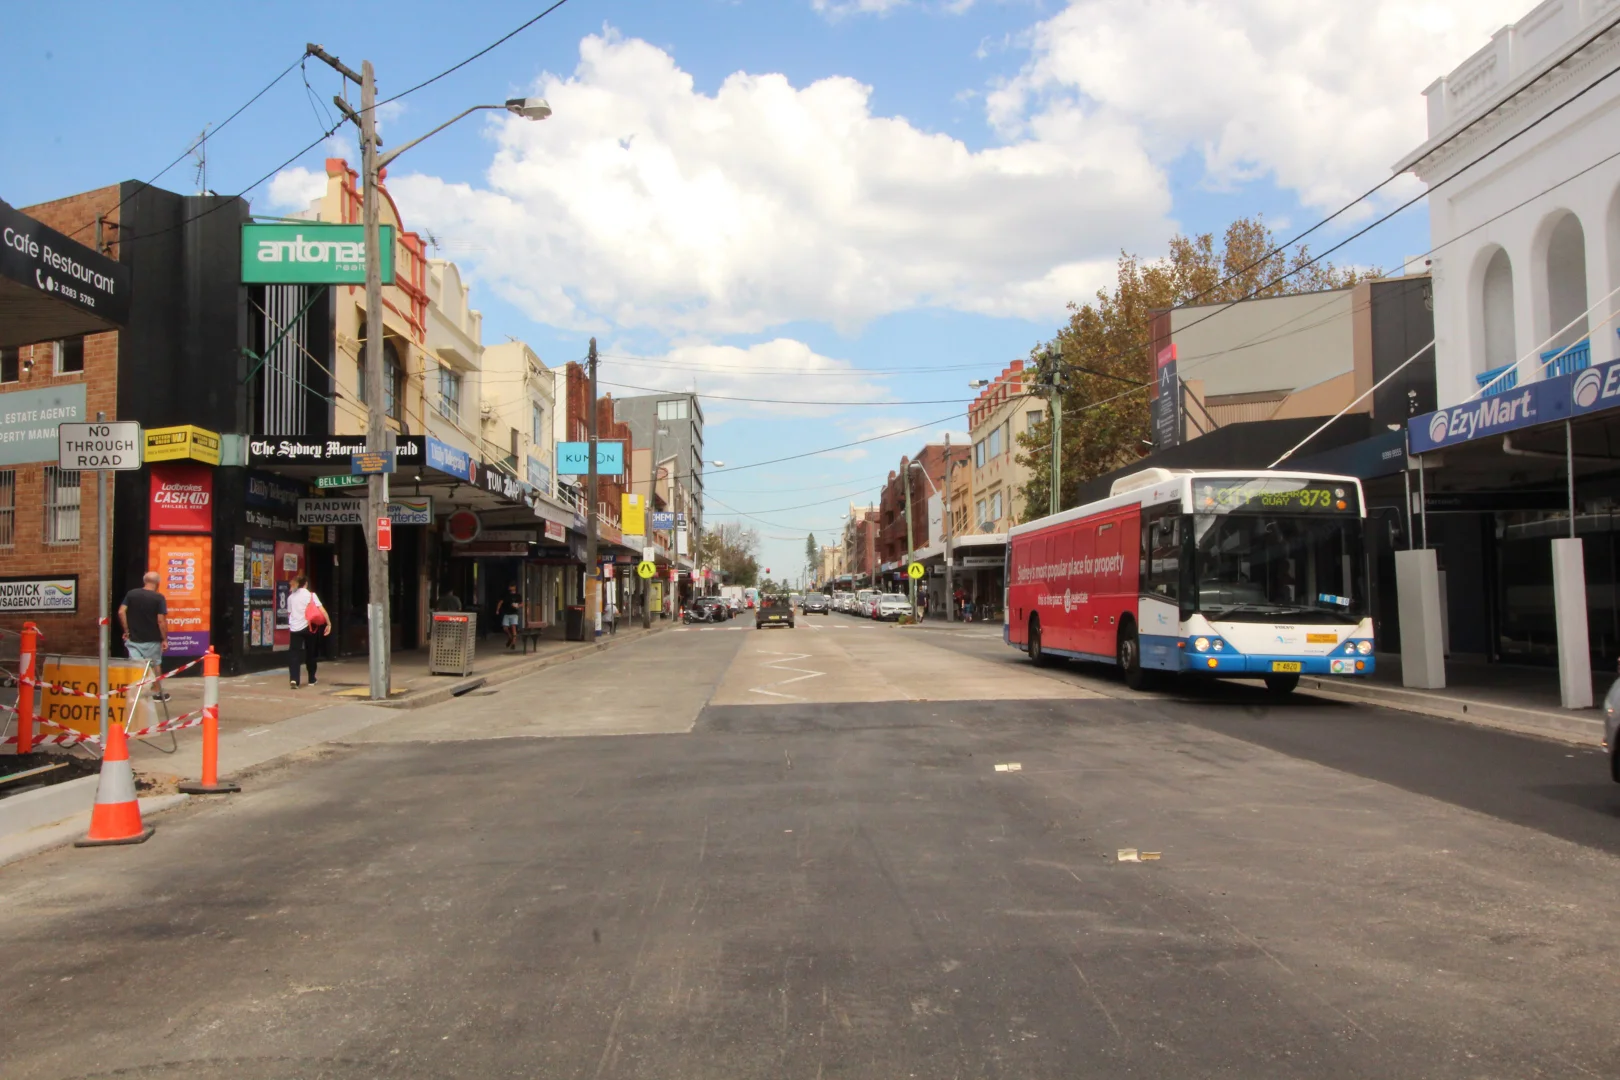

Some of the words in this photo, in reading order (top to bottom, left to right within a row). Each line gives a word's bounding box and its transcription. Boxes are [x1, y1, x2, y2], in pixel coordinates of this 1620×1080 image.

[4, 227, 39, 258] Cafe
[43, 245, 115, 295] Restaurant
[335, 263, 366, 272] realt
[61, 284, 77, 299] 8283
[79, 293, 95, 307] 5782
[5, 410, 38, 424] ESTATE
[40, 406, 77, 420] AGENTS
[1448, 389, 1532, 439] EzyMart
[28, 427, 59, 441] MANA
[88, 426, 110, 437] NO
[66, 440, 134, 451] THROUGH
[251, 441, 275, 457] The
[277, 441, 322, 458] Sydney
[326, 441, 366, 458] Morni
[396, 441, 418, 456] rald
[77, 455, 122, 466] ROAD
[162, 483, 203, 491] Ladbrokes
[318, 477, 338, 487] BELL
[341, 476, 352, 484] LN
[154, 491, 189, 503] CASH
[1262, 497, 1290, 505] QUAY
[1300, 489, 1331, 507] 373
[653, 513, 684, 521] CHEMIT
[1068, 557, 1083, 579] place
[1084, 555, 1094, 573] for
[1094, 552, 1124, 577] property
[166, 617, 202, 626] maysim
